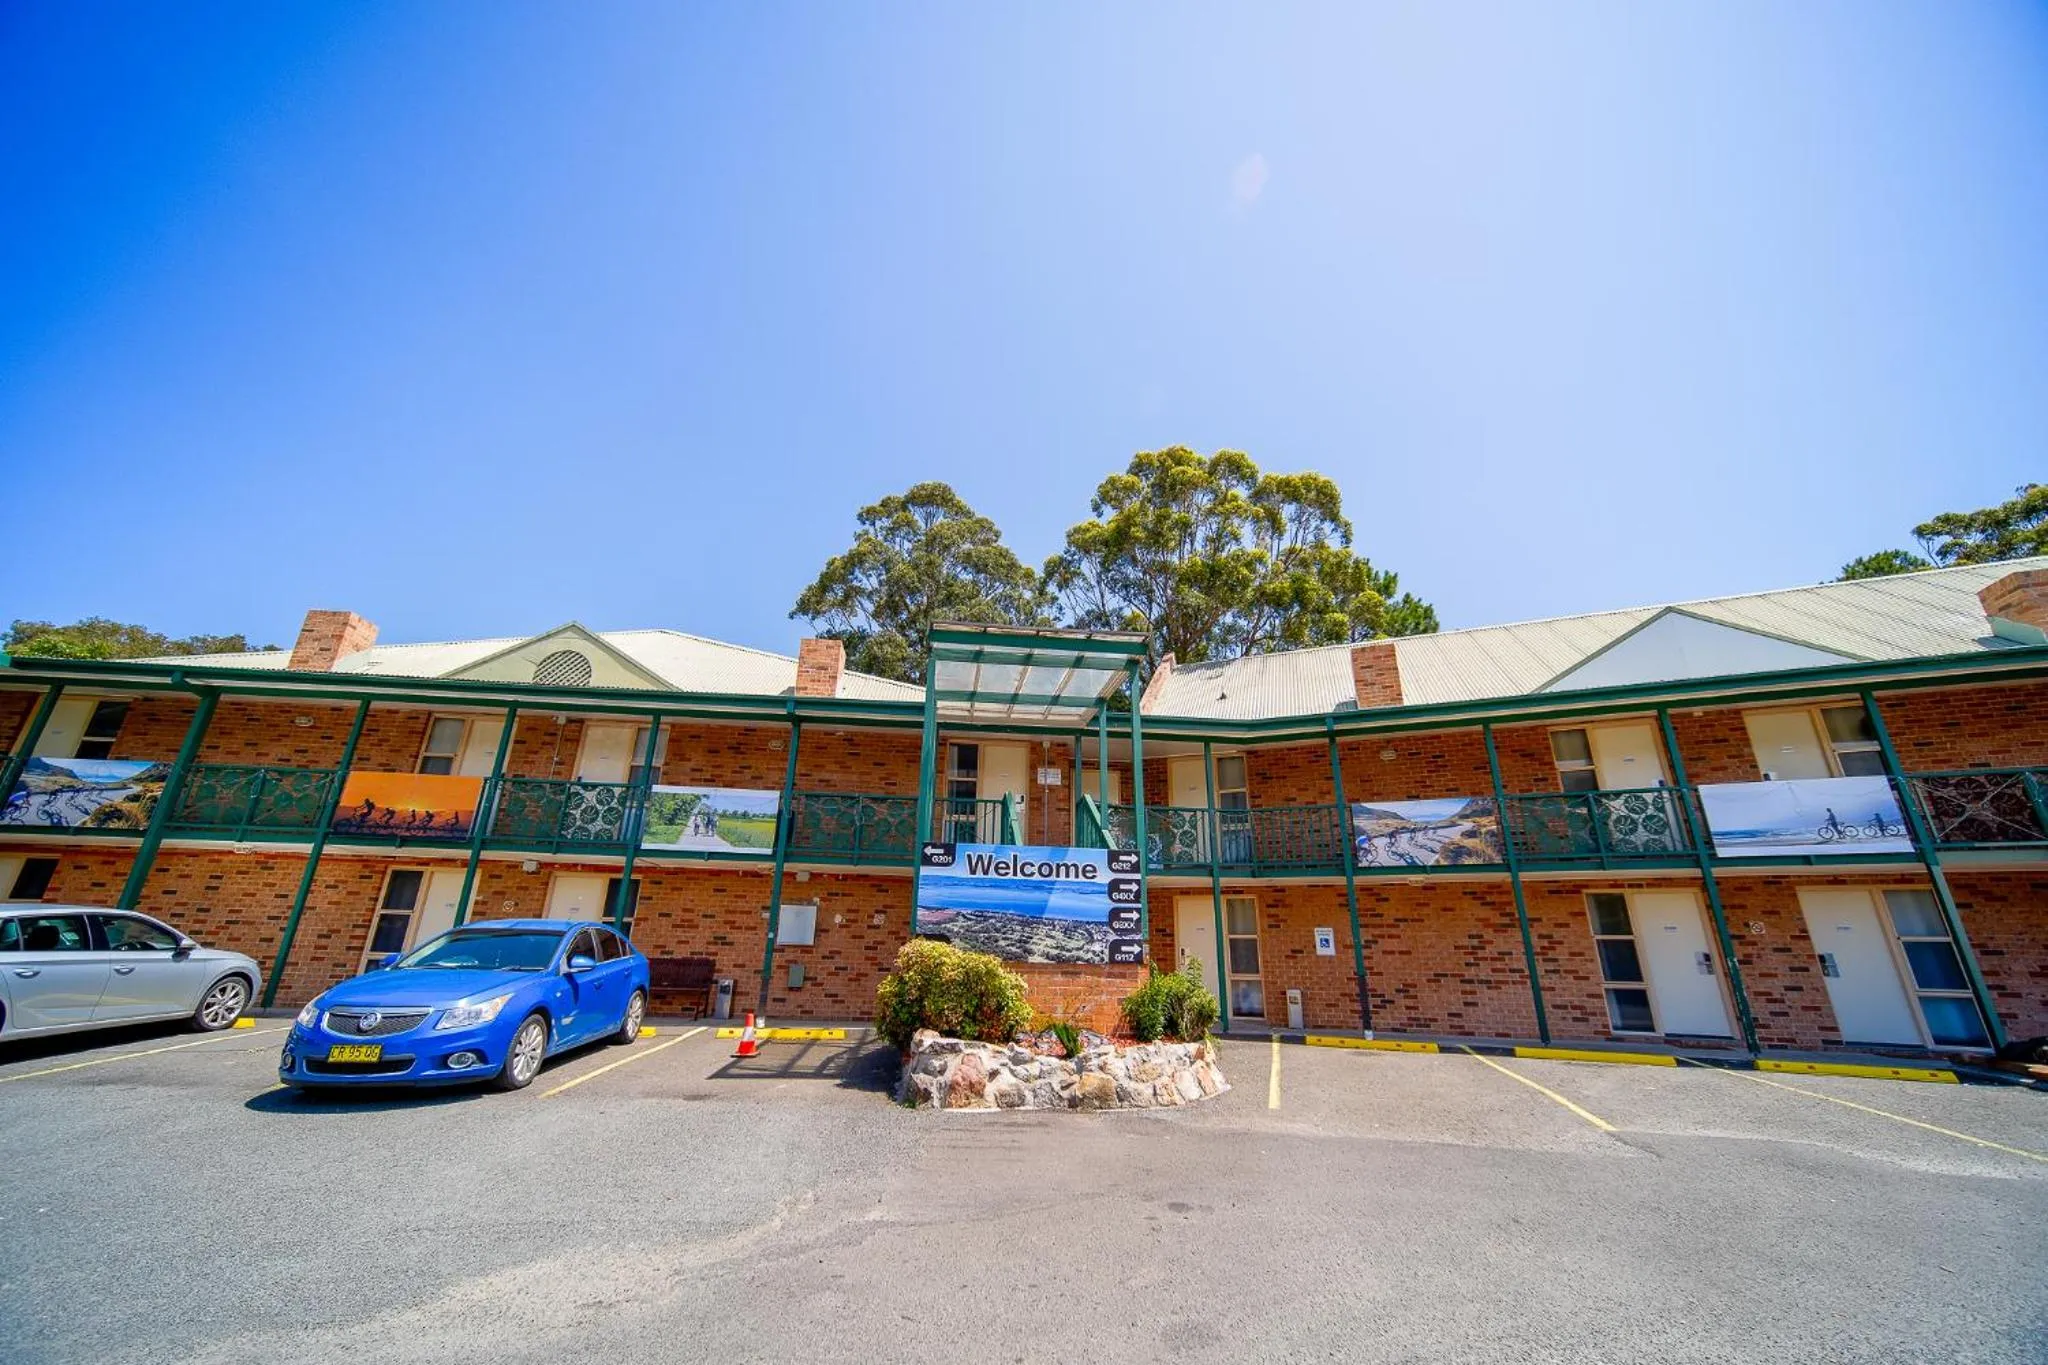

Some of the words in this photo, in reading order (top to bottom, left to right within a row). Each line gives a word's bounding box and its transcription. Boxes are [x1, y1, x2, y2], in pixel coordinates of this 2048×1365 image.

[931, 855, 953, 864] G201
[966, 852, 1098, 880] Welcome
[1111, 862, 1132, 870] G212
[1112, 892, 1135, 900] G4XX
[1114, 953, 1135, 962] G112
